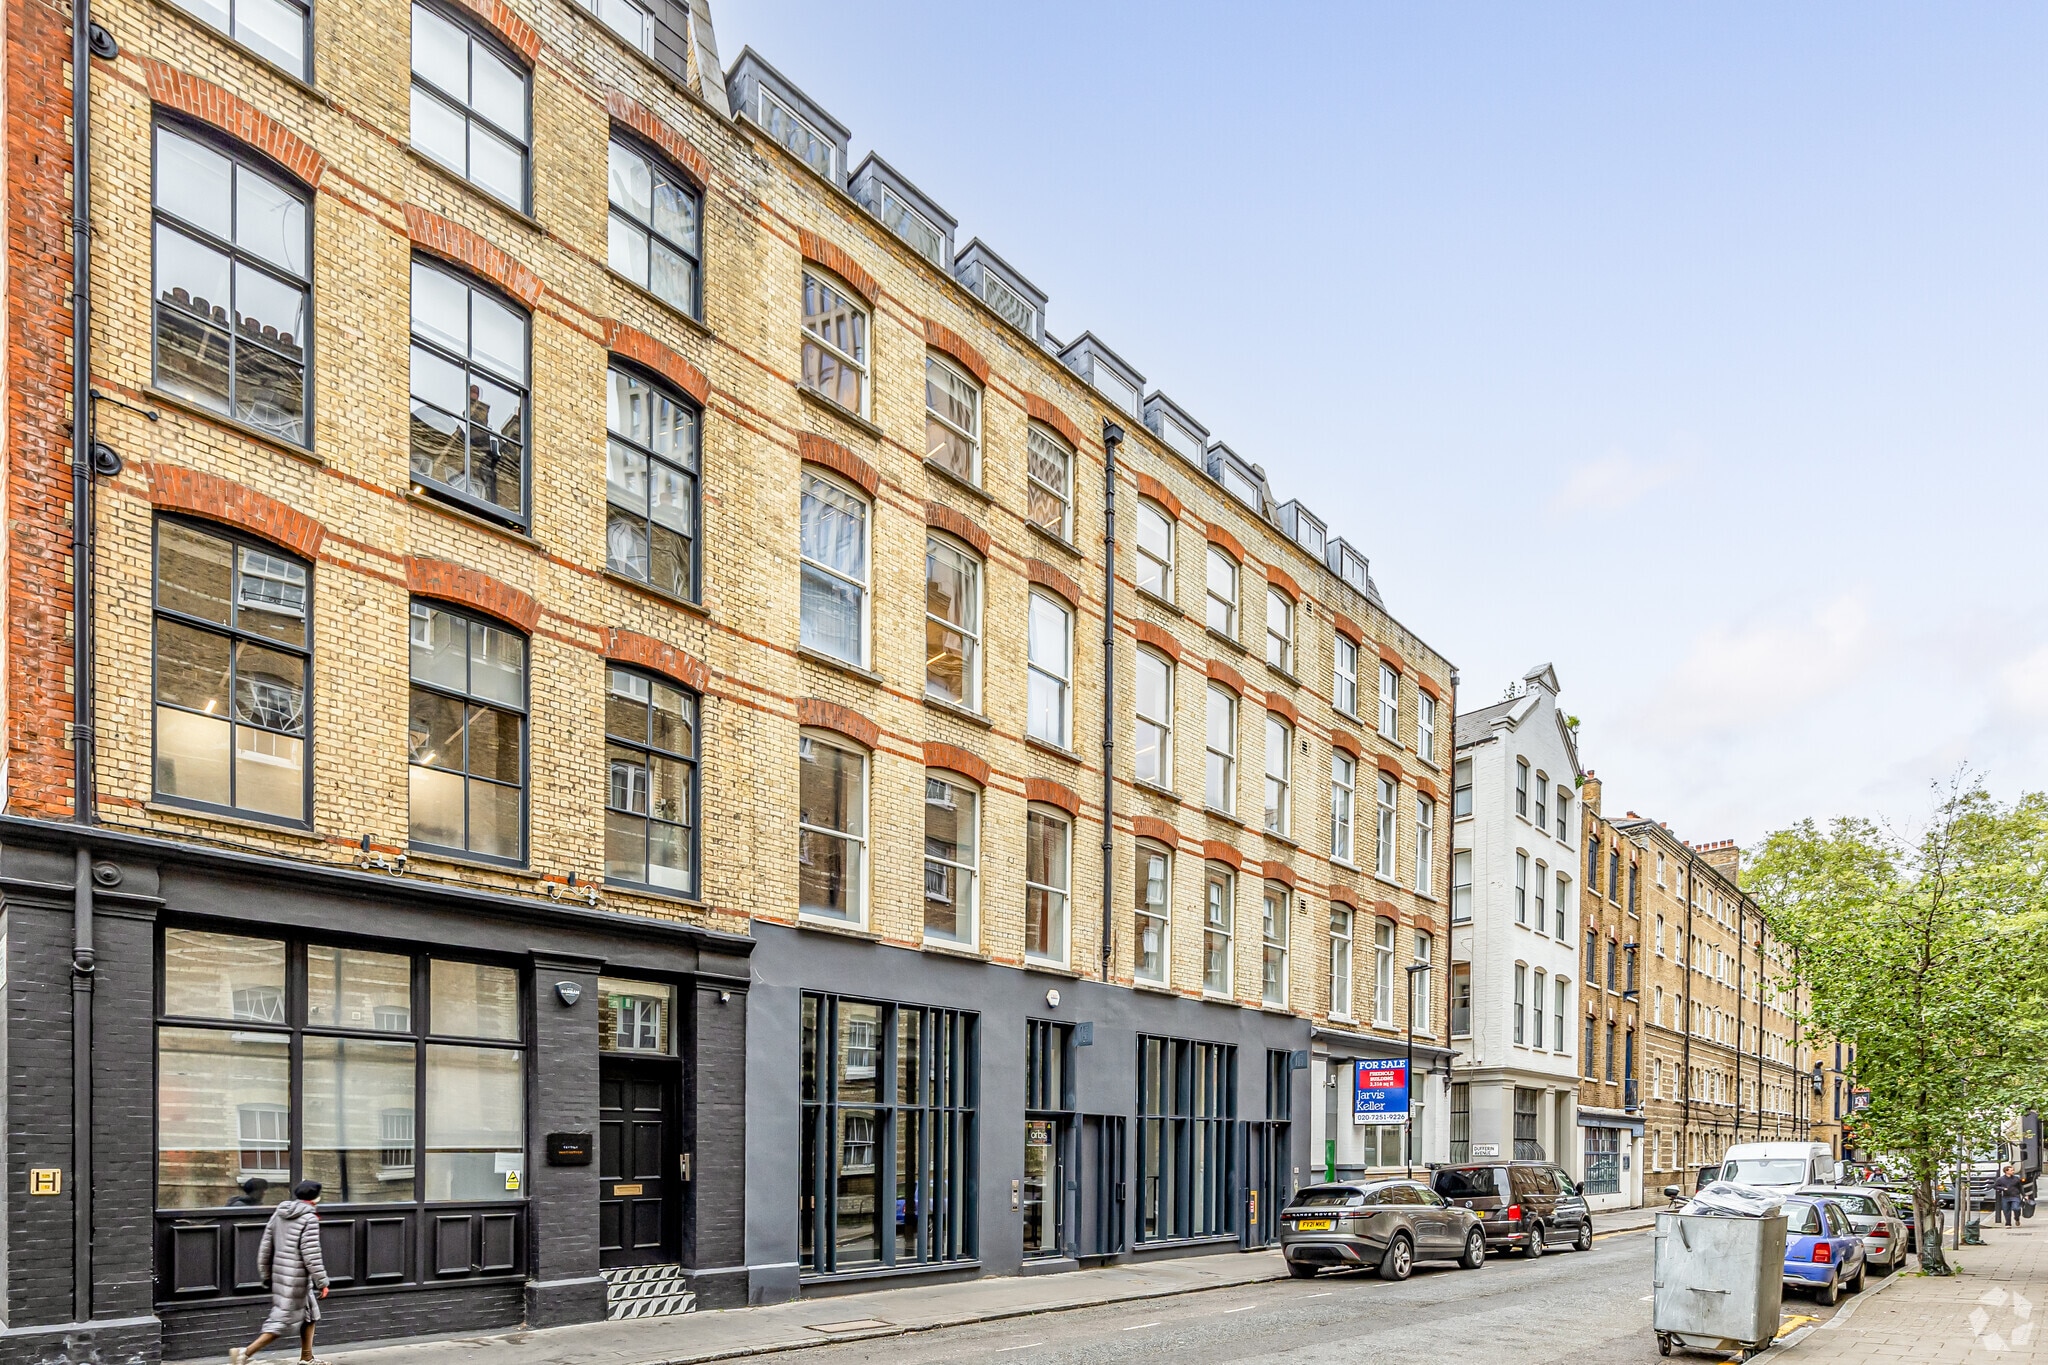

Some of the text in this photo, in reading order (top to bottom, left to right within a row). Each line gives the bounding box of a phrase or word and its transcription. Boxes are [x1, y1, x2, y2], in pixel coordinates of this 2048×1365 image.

[1359, 1060, 1405, 1069] FOR SALE
[1358, 1090, 1385, 1100] Jarvis
[1356, 1101, 1385, 1110] Keller
[1031, 1129, 1048, 1139] orbis
[36, 1171, 56, 1191] H
